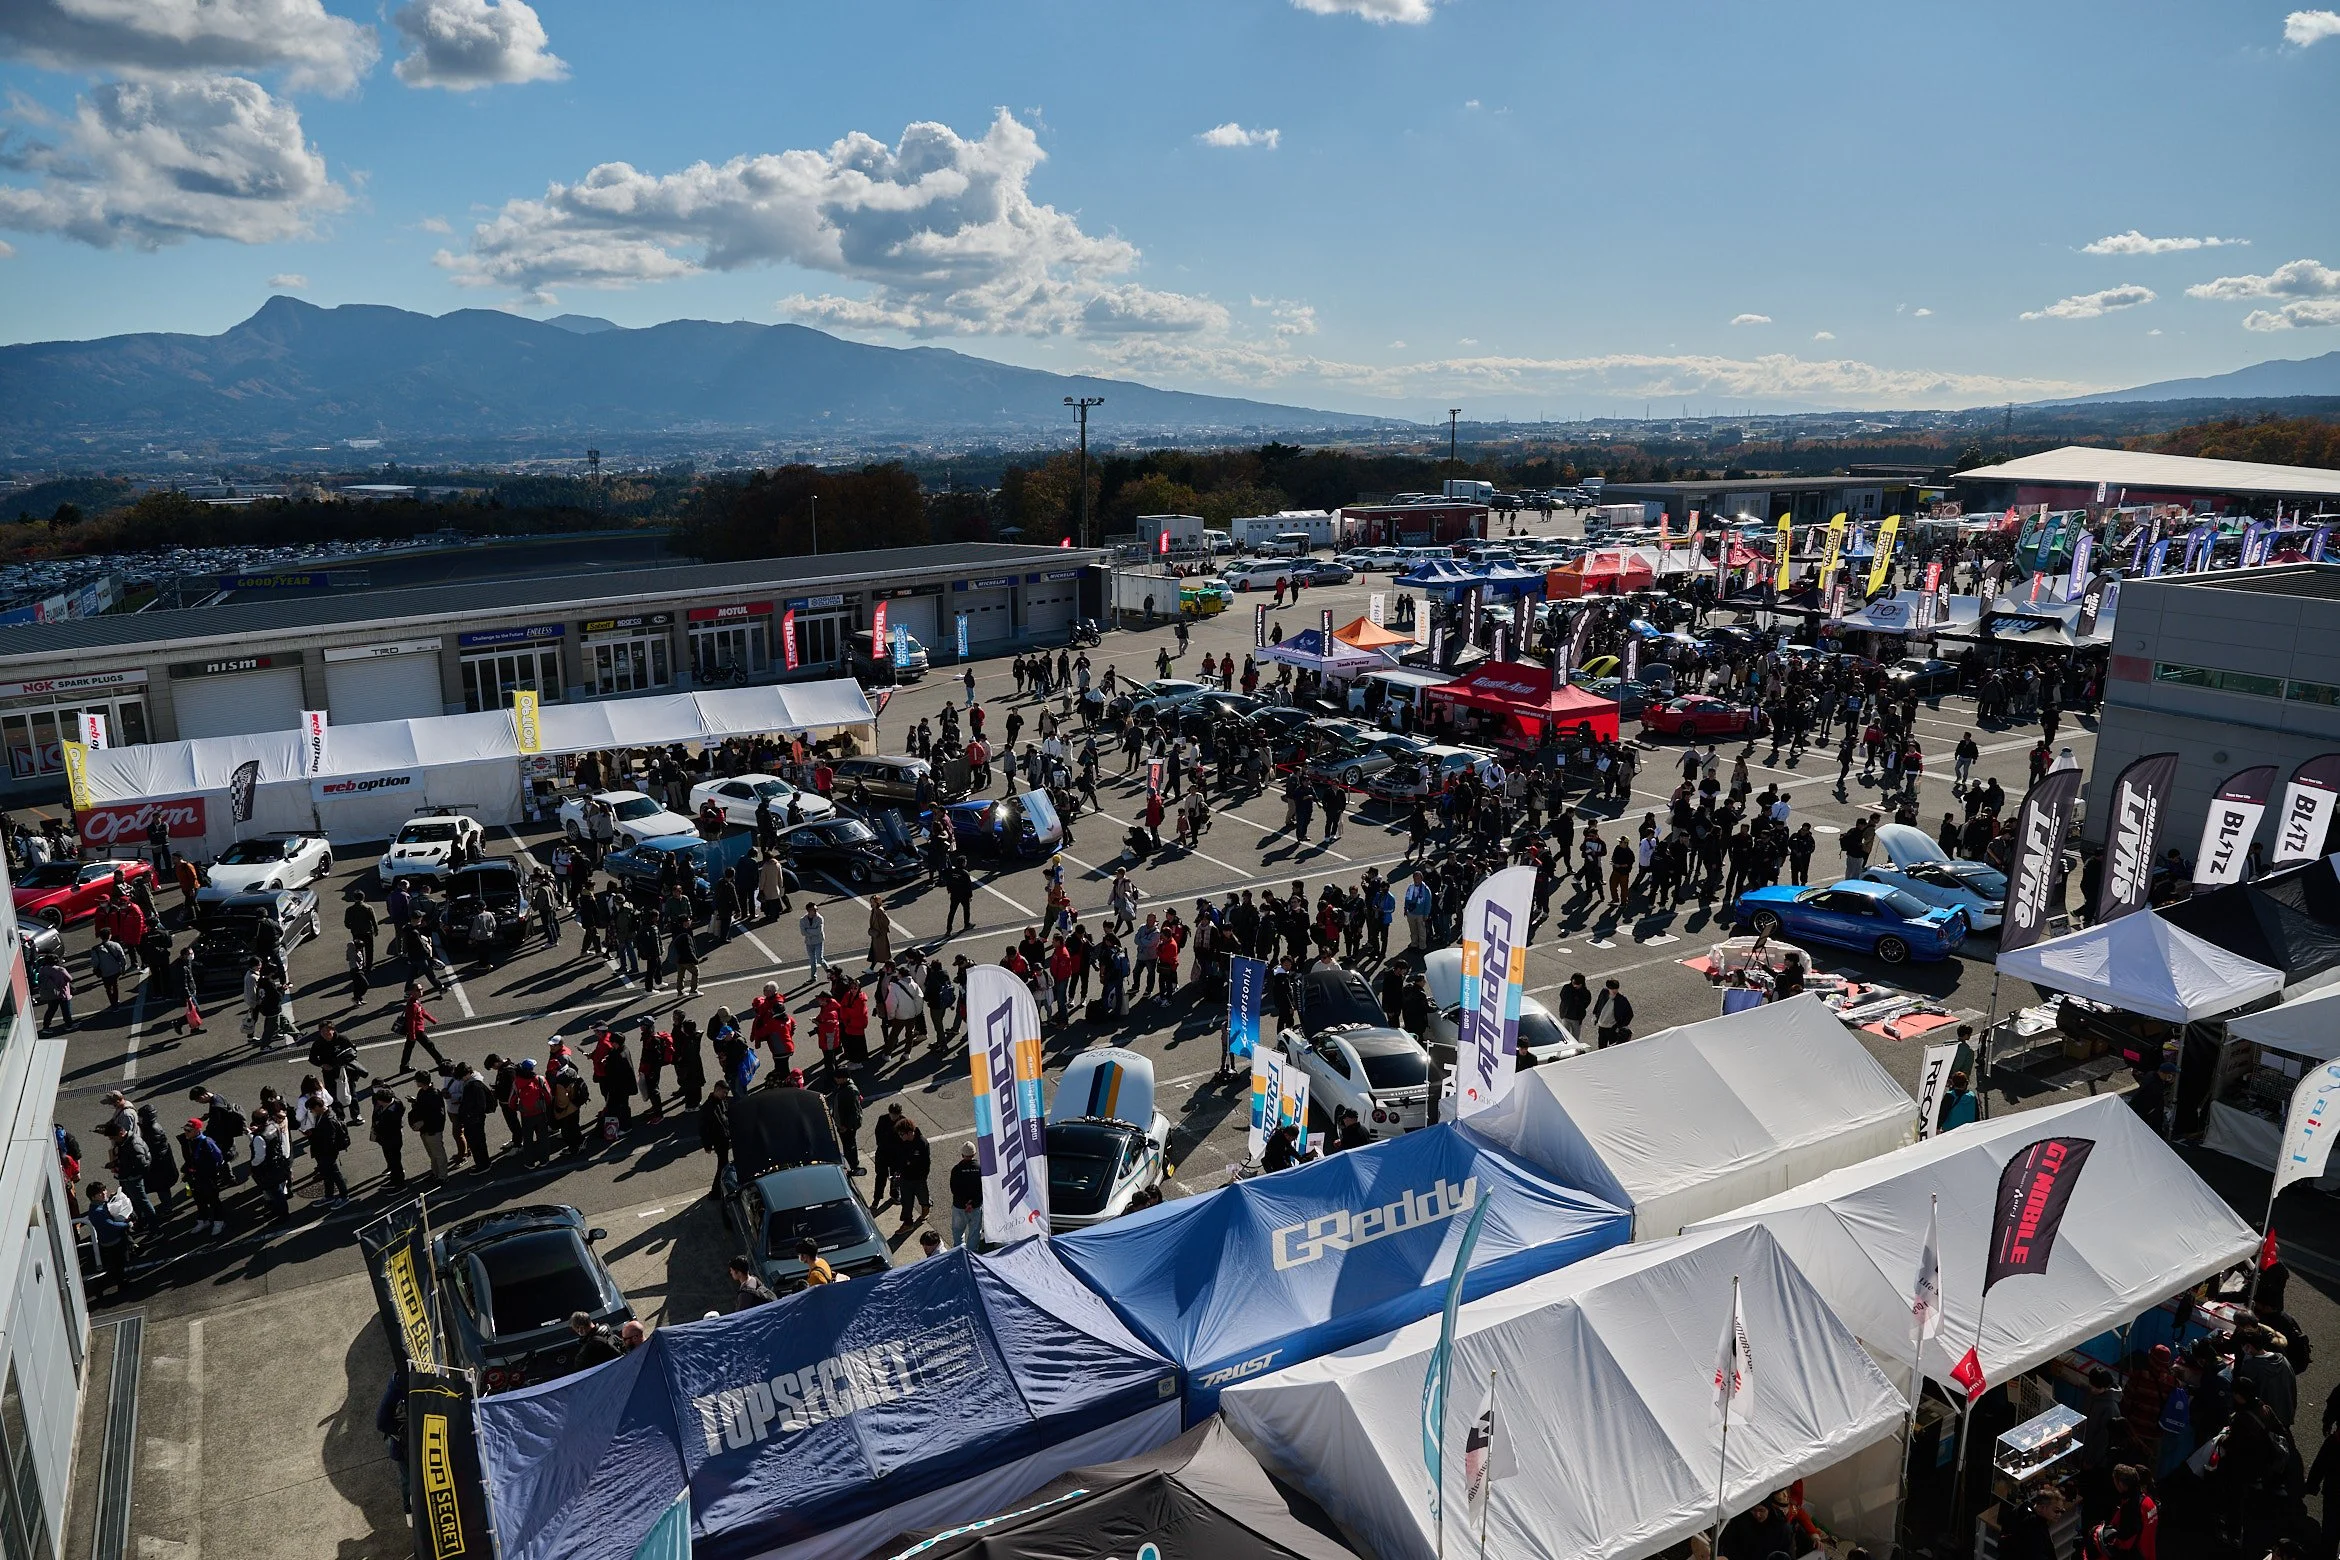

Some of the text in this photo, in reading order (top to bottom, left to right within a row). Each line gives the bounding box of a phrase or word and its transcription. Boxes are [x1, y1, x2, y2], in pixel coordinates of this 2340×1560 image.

[1823, 530, 1836, 567] TARMAC
[1873, 533, 1887, 571] TARMAC
[2076, 543, 2086, 581] MICHELIN
[2244, 529, 2255, 565] MICHELIN
[237, 574, 310, 587] GOODYEAR
[1049, 571, 1076, 579] MICHELIN
[1987, 576, 1997, 600] MINI
[616, 617, 642, 626] sparco
[718, 606, 748, 617] MOTUL
[1468, 589, 1477, 645] NITTO
[1519, 595, 1530, 651] NITTO
[1991, 618, 2039, 629] MINI
[2082, 594, 2092, 616] GT
[2086, 592, 2100, 618] MINI
[527, 627, 553, 637] ENDLESS
[784, 619, 797, 663] MOTUL
[876, 610, 884, 652] MOTUL
[1323, 629, 1331, 657] Factory
[371, 647, 399, 655] TRD
[1409, 662, 1441, 671] NITO
[22, 674, 124, 693] NGK SPARK PLUGS
[89, 716, 101, 739] web
[311, 713, 323, 773] web option
[323, 776, 411, 793] web option
[2111, 780, 2146, 904] SHAFT
[2284, 793, 2318, 853] BLITZ
[2137, 797, 2157, 890] AutoService
[2210, 810, 2246, 876] BLITZ
[2015, 799, 2052, 928] SHAFT
[1241, 966, 1252, 1033] supersonix
[1463, 955, 1473, 1030] www.trust-power.com
[1477, 899, 1512, 1093] GReddy
[2010, 1141, 2068, 1265] GT MOBILE
[1272, 1175, 1478, 1272] GReddy
[398, 1260, 420, 1318] TOP
[1199, 1348, 1283, 1389] TRUST
[427, 1427, 446, 1485] TOP
[436, 1492, 459, 1549] SECRET
